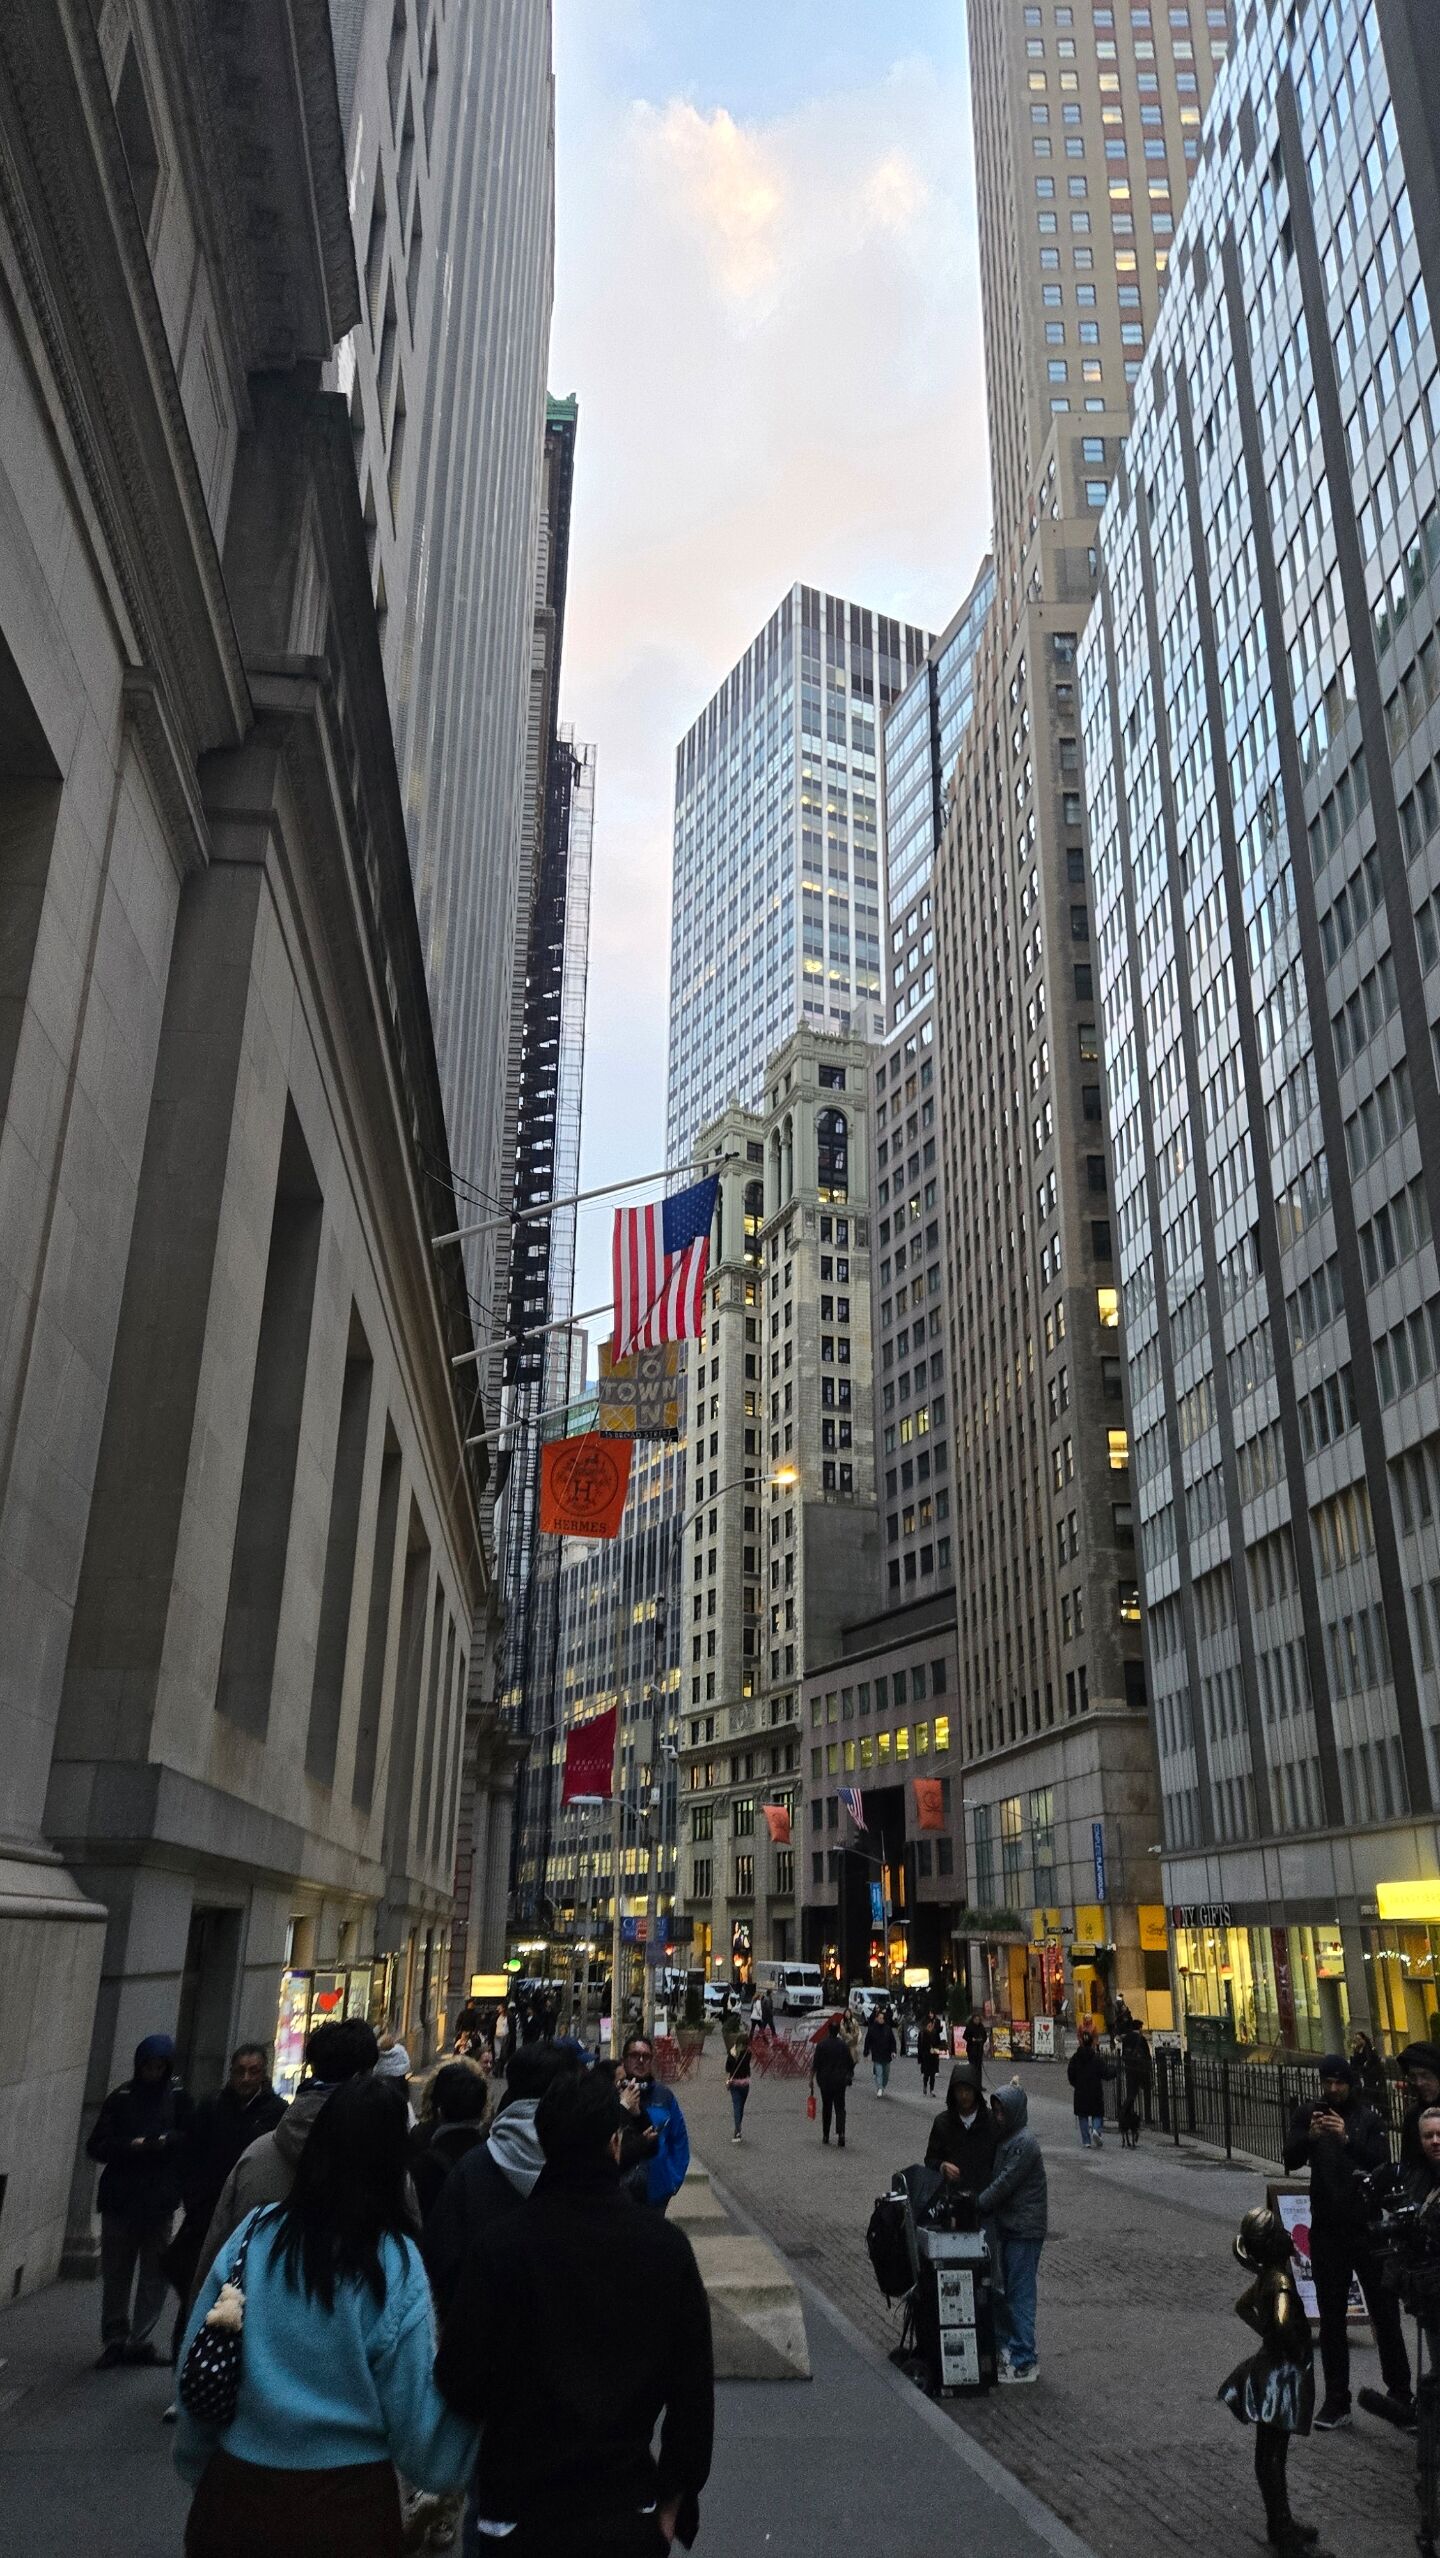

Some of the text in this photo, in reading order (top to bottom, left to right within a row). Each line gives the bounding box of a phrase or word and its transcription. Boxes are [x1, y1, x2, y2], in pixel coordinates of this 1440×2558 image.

[600, 1378, 677, 1402] TOWN
[615, 1430, 641, 1438] BROAD
[644, 1429, 672, 1438] STREET
[554, 1518, 607, 1533] HERMES
[1169, 1904, 1232, 1928] I NY GIFTS
[1038, 2032, 1051, 2040] NY
